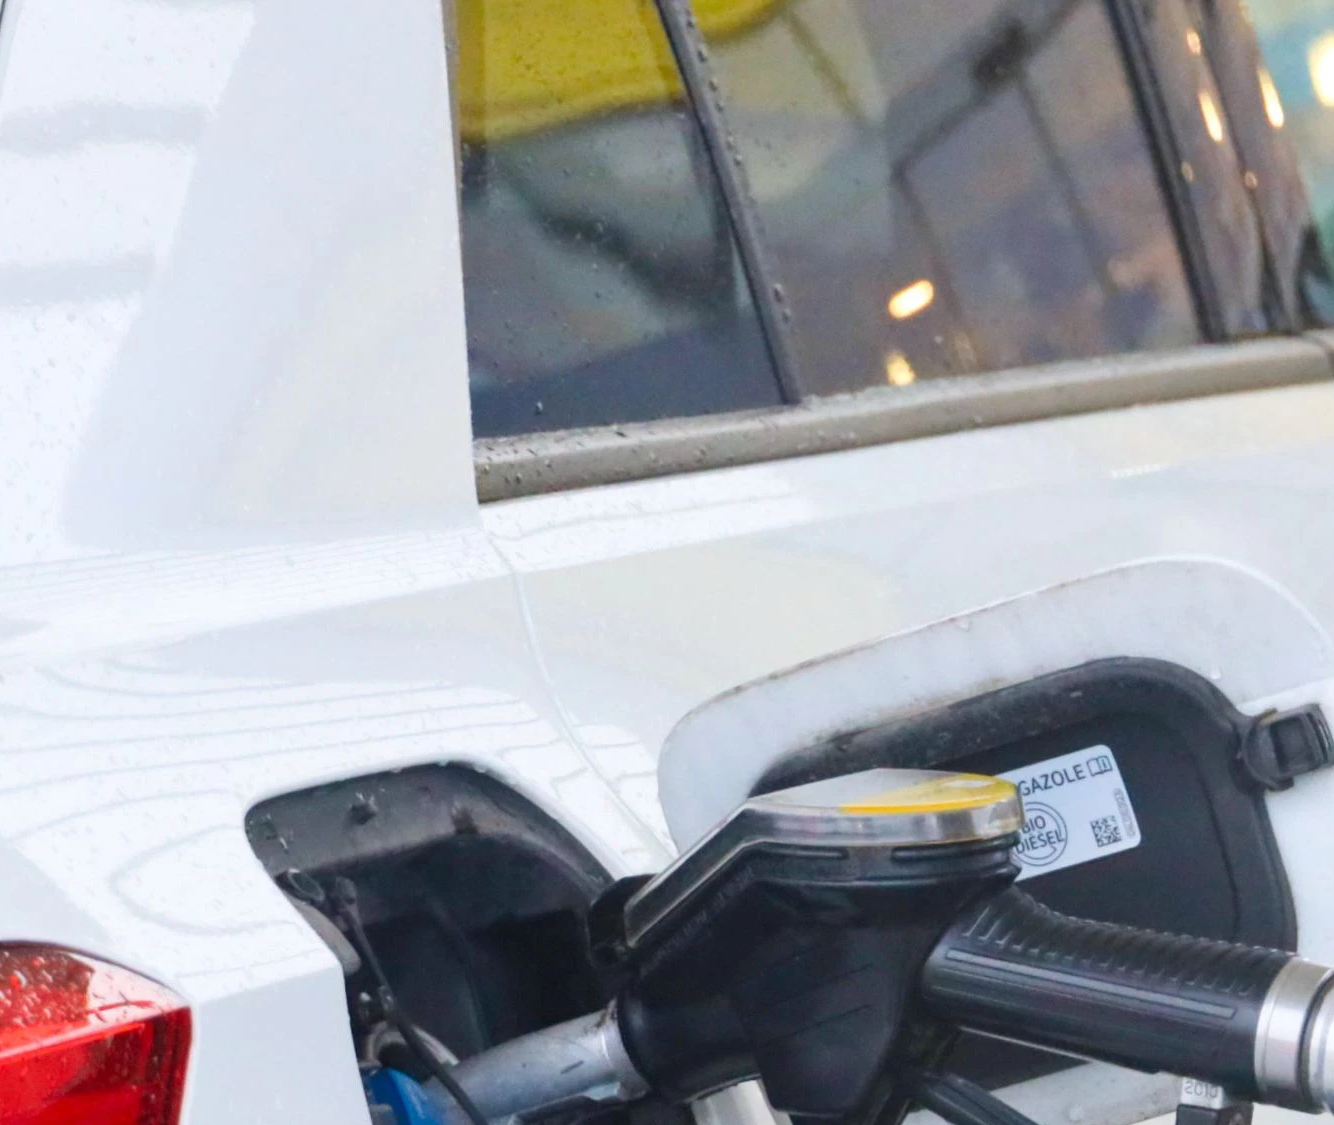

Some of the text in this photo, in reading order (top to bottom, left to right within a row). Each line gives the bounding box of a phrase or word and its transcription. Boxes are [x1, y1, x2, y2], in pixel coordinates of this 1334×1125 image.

[1018, 764, 1086, 796] GAZOLE
[1022, 815, 1046, 834] BIO
[1016, 830, 1066, 854] DIESEL
